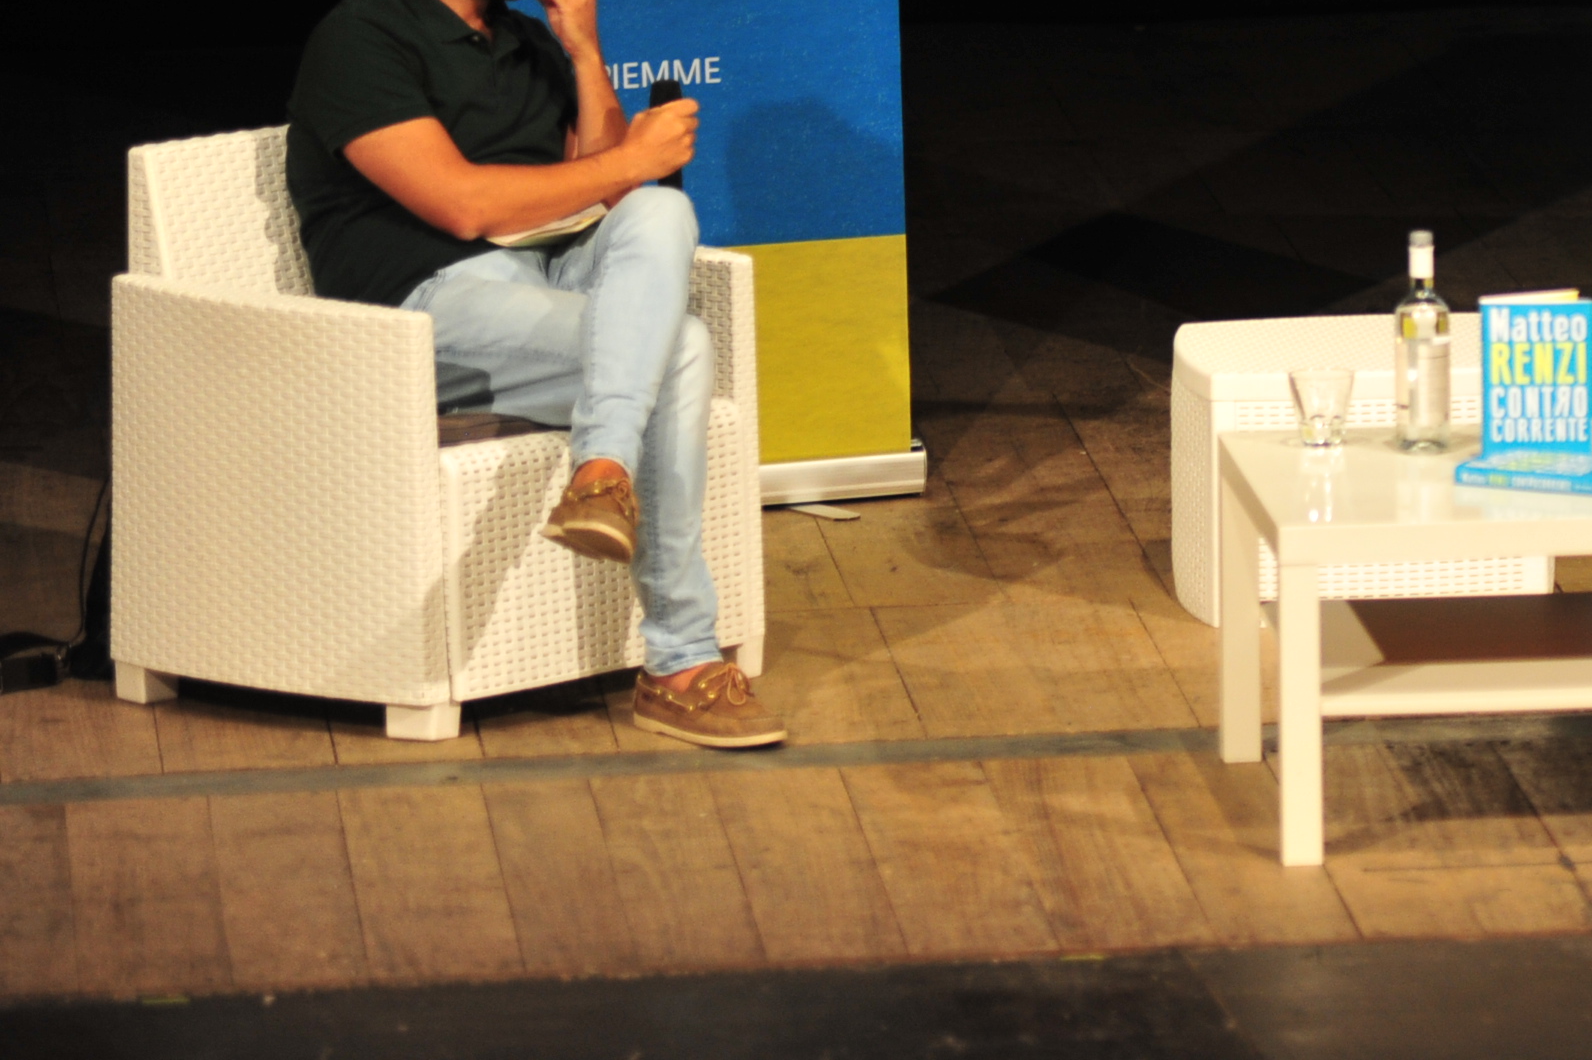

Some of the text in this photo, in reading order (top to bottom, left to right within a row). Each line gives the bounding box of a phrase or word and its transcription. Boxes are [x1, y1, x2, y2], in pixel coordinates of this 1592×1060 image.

[605, 56, 722, 91] IEMME
[1489, 306, 1588, 342] Matteo
[1491, 341, 1588, 385] RENZI
[1490, 418, 1589, 443] CORRENTE
